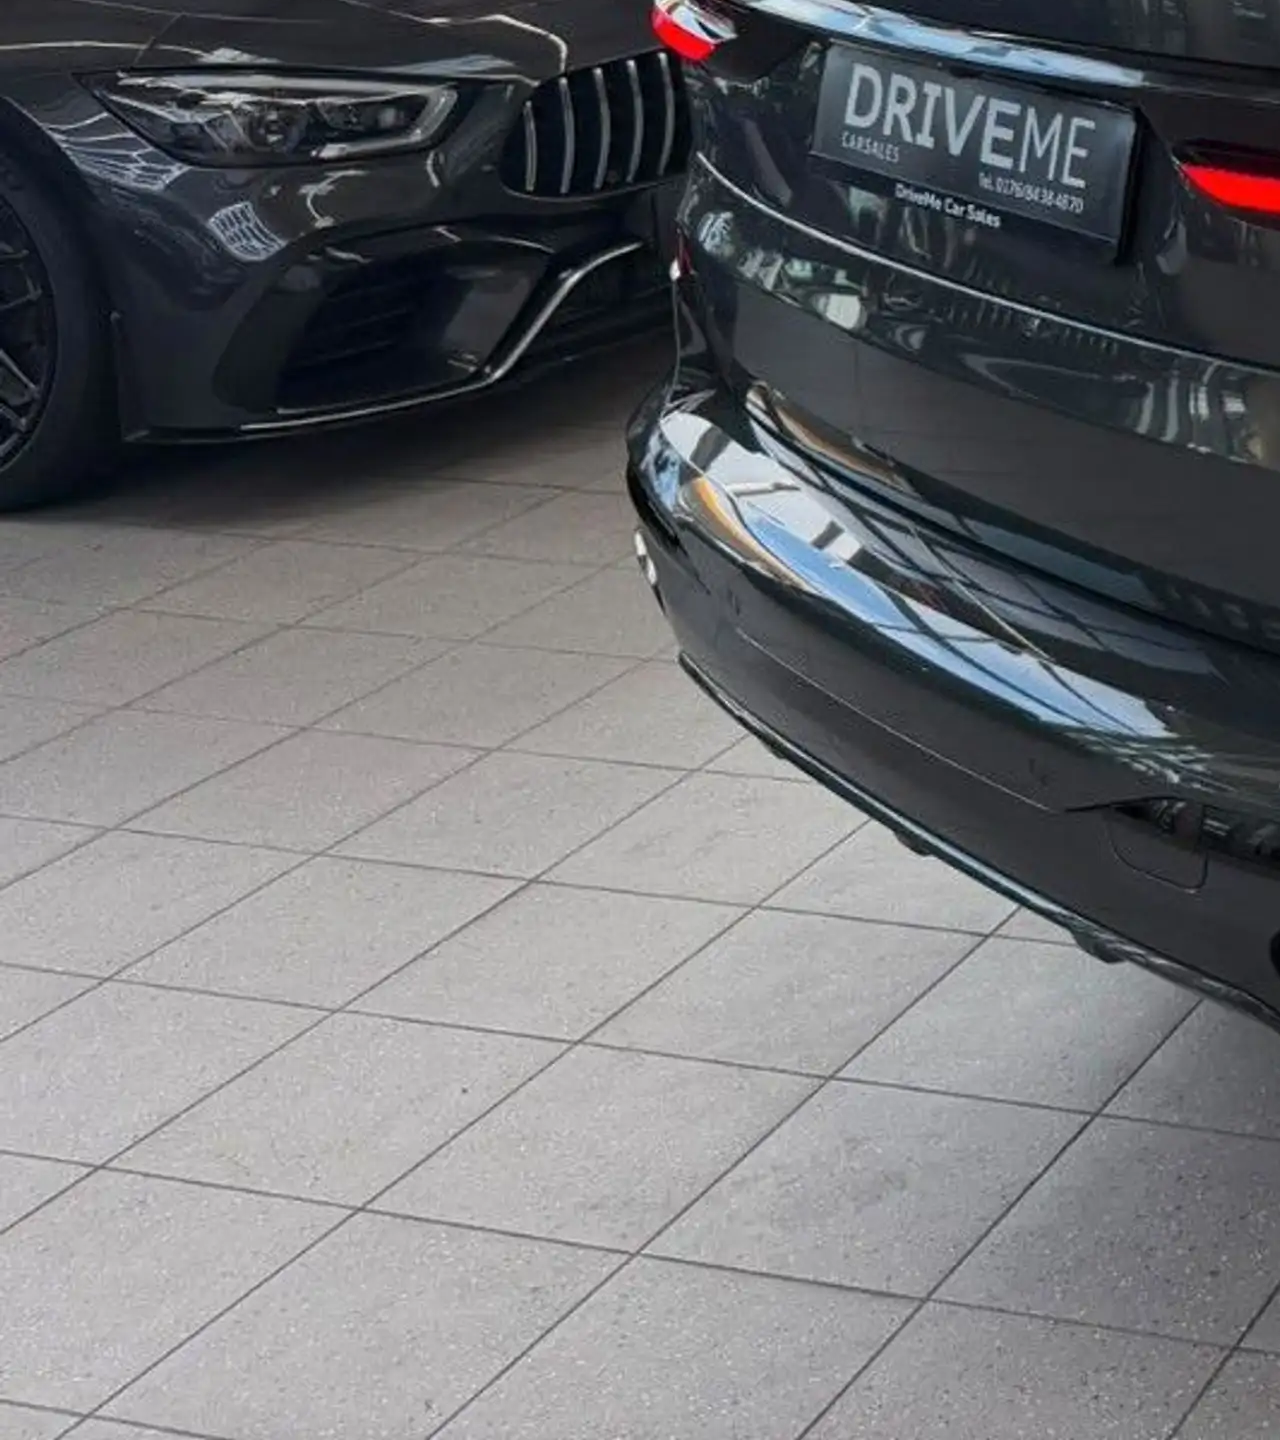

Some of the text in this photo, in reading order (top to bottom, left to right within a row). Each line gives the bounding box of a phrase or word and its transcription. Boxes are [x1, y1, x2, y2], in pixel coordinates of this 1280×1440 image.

[841, 129, 901, 164] CARSALES
[844, 62, 1096, 190] DRIVEME
[894, 182, 1002, 229] DriveMe Car Sales
